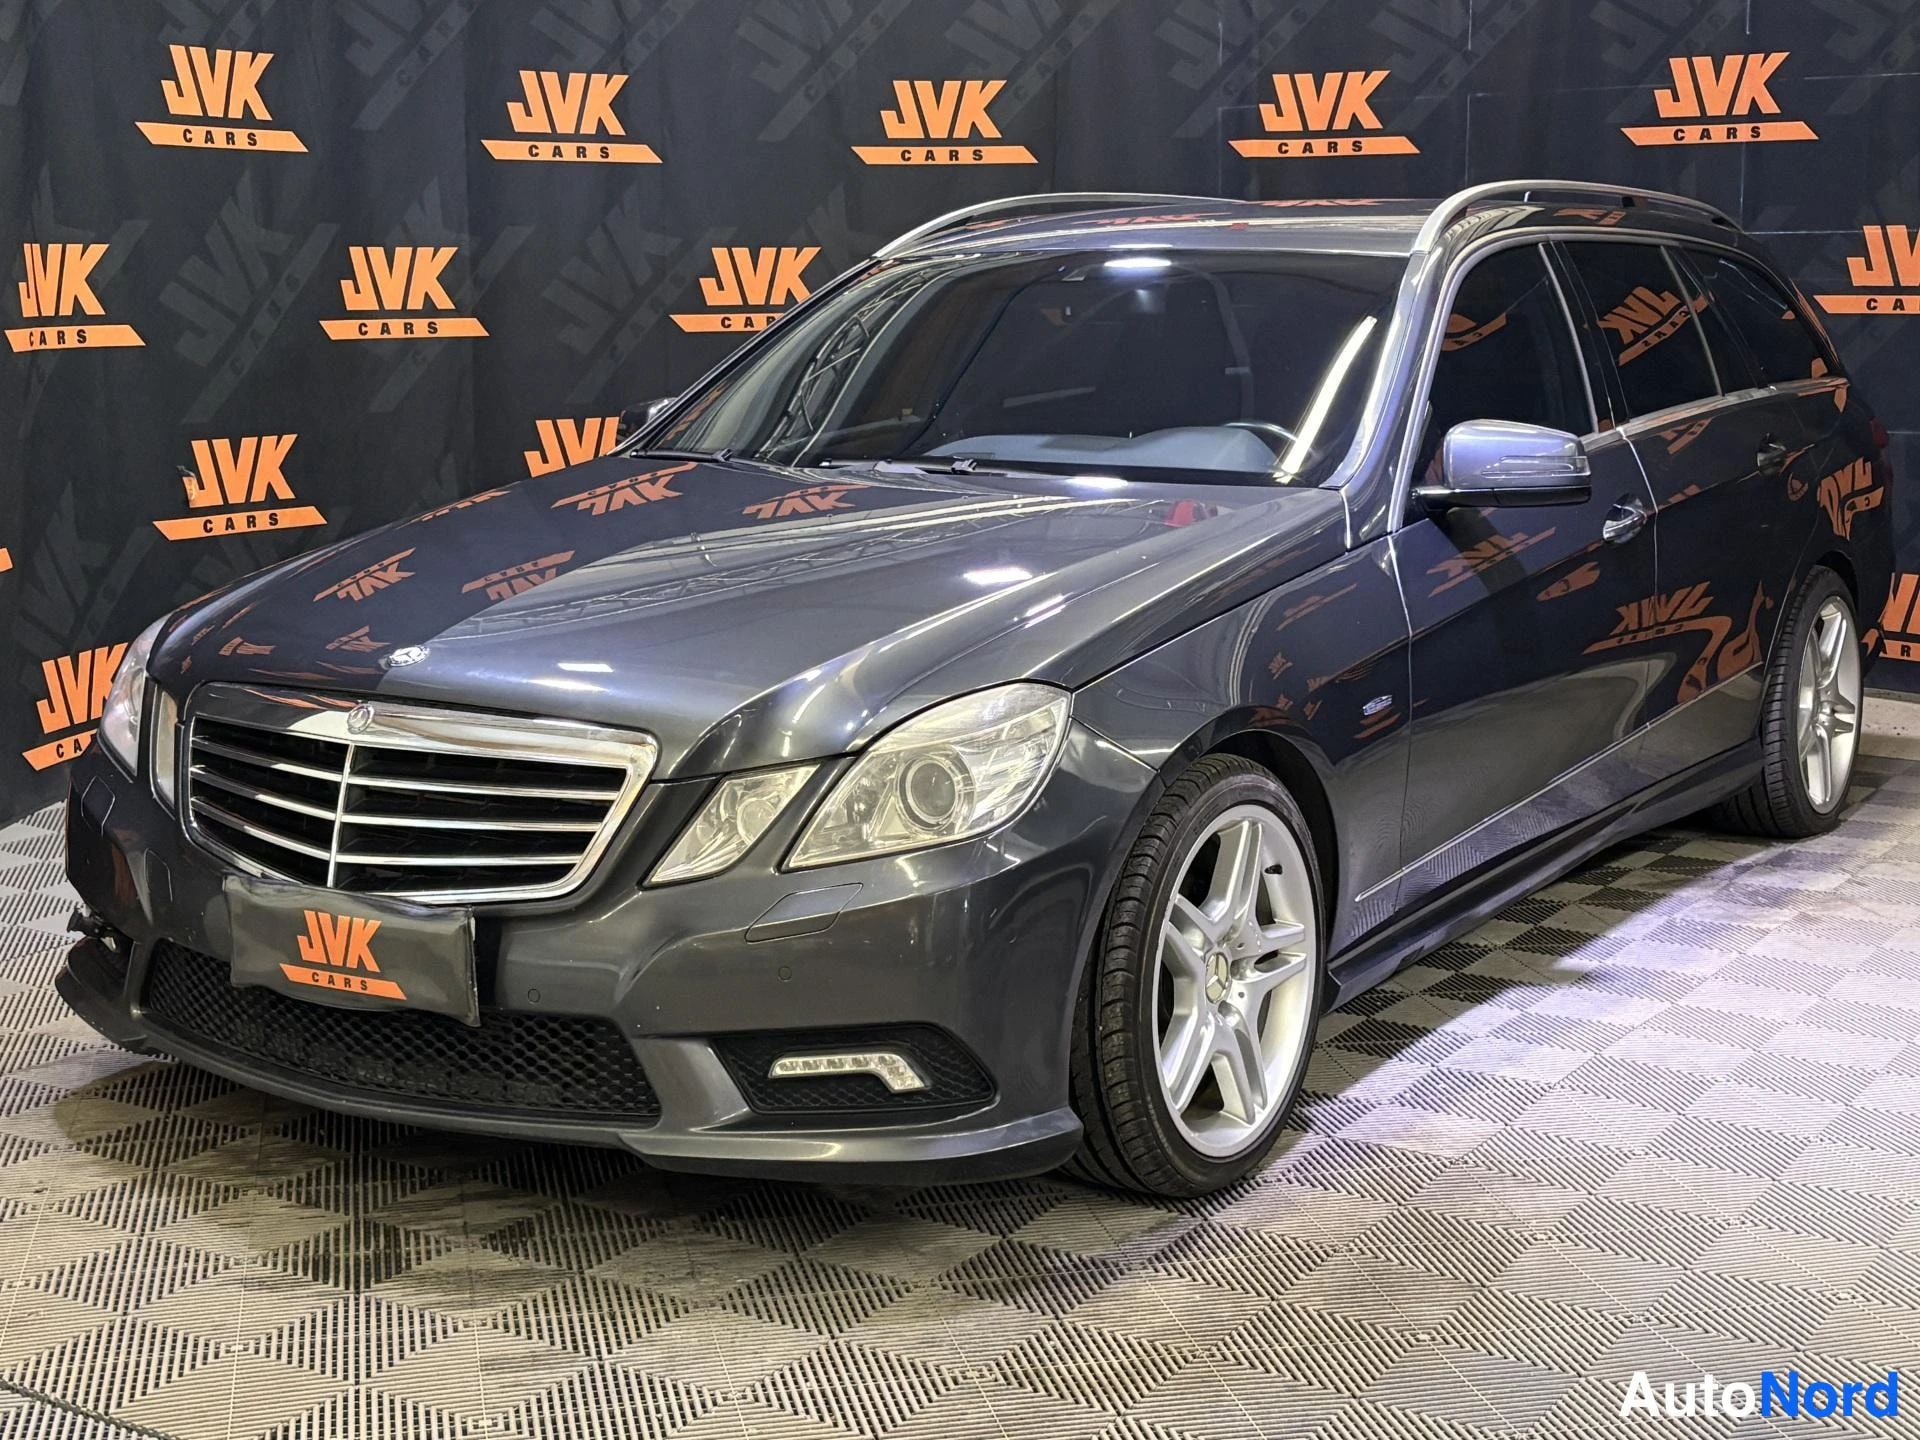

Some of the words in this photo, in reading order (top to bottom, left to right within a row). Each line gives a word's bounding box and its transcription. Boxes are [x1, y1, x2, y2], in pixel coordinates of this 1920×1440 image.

[161, 44, 275, 121] JVK
[506, 70, 629, 136] JVK
[880, 80, 1007, 139] JVK
[1259, 70, 1390, 132] JVK
[1654, 52, 1789, 118] JVK
[183, 129, 257, 146] CARS
[529, 145, 610, 158] CARS
[901, 150, 983, 161] CARS
[1278, 141, 1363, 154] CARS
[1674, 126, 1761, 141] CARS
[18, 243, 109, 317] JVK
[340, 247, 458, 310] JVK
[699, 247, 822, 306] JVK
[1846, 225, 1920, 286] JV
[28, 329, 87, 347] CARS
[359, 322, 438, 336] CARS
[721, 316, 777, 329] CAR
[182, 433, 298, 508] JVK
[203, 513, 279, 534] CARS
[36, 642, 128, 734] JVK
[56, 738, 83, 758] CA
[297, 909, 382, 973] JVK
[311, 972, 368, 991] CARS
